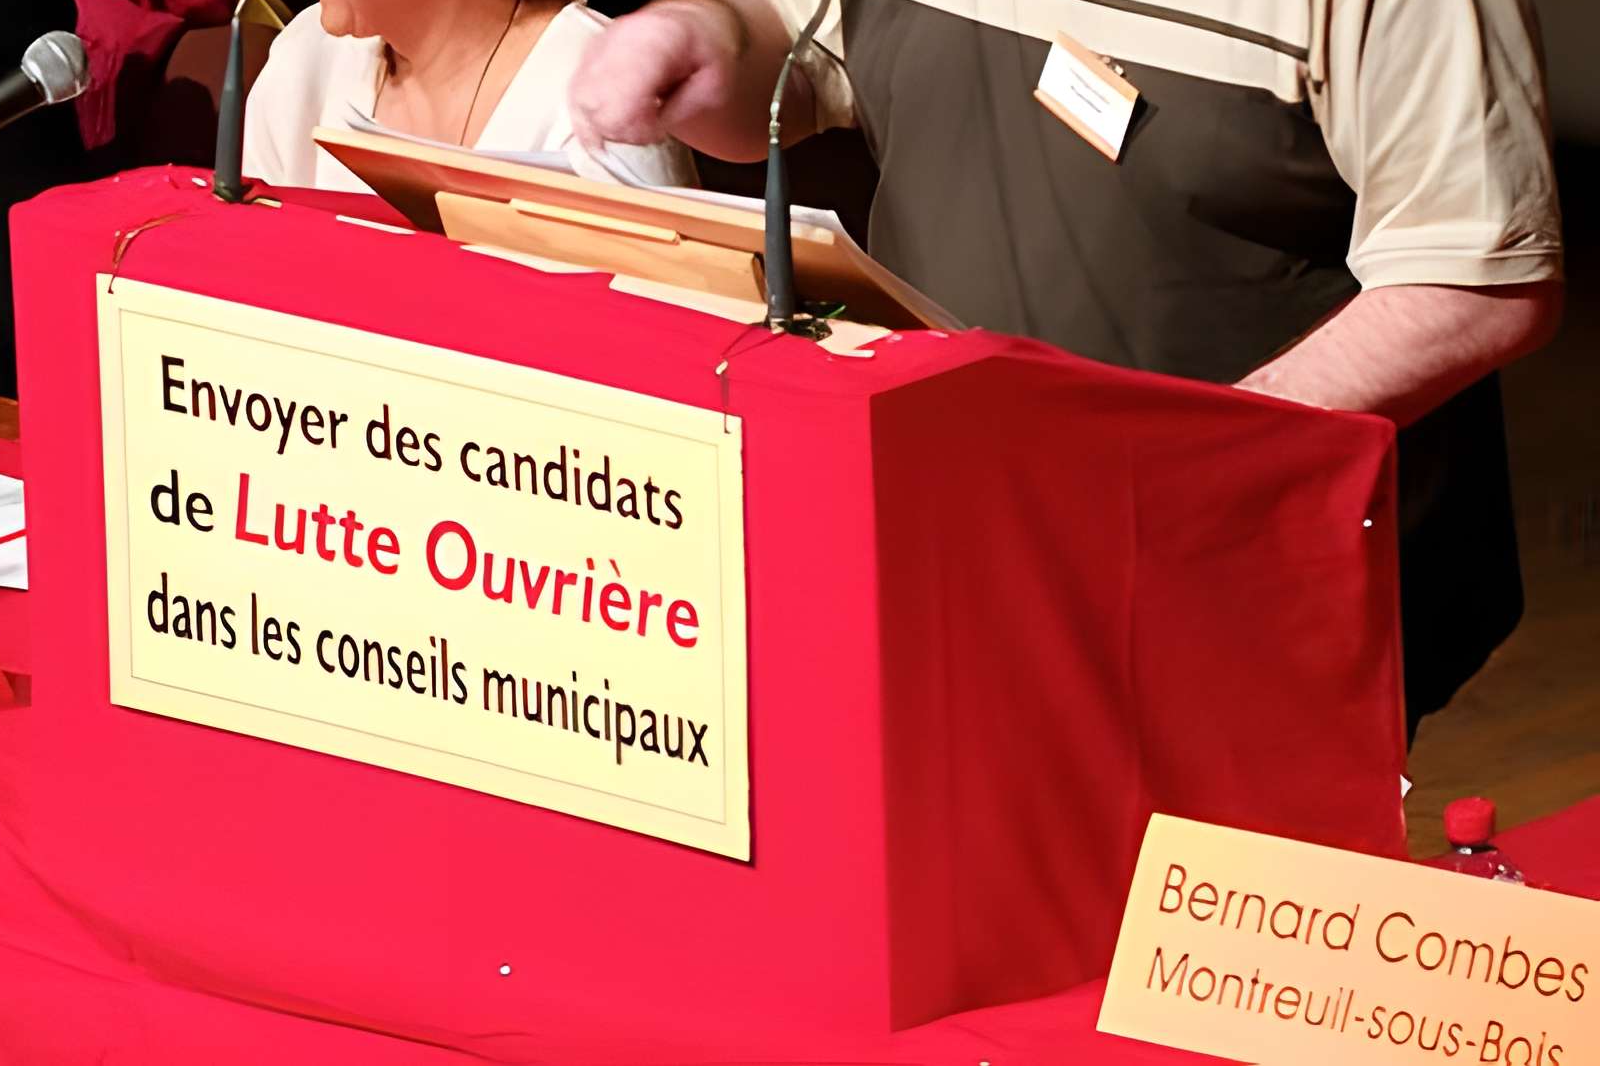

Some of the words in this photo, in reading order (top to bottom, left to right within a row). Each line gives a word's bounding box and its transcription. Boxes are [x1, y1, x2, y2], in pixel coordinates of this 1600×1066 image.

[160, 354, 349, 455] Envoyer
[366, 404, 443, 471] des
[460, 440, 684, 530] candidats
[150, 469, 214, 532] de
[234, 472, 401, 575] Lutte
[425, 519, 701, 648] Ouvrière
[146, 571, 237, 650] dans
[251, 593, 301, 666] les
[316, 629, 468, 706] conseils
[483, 668, 710, 767] municipaux
[1159, 864, 1360, 951] Bernard
[1375, 912, 1589, 1003] Combes
